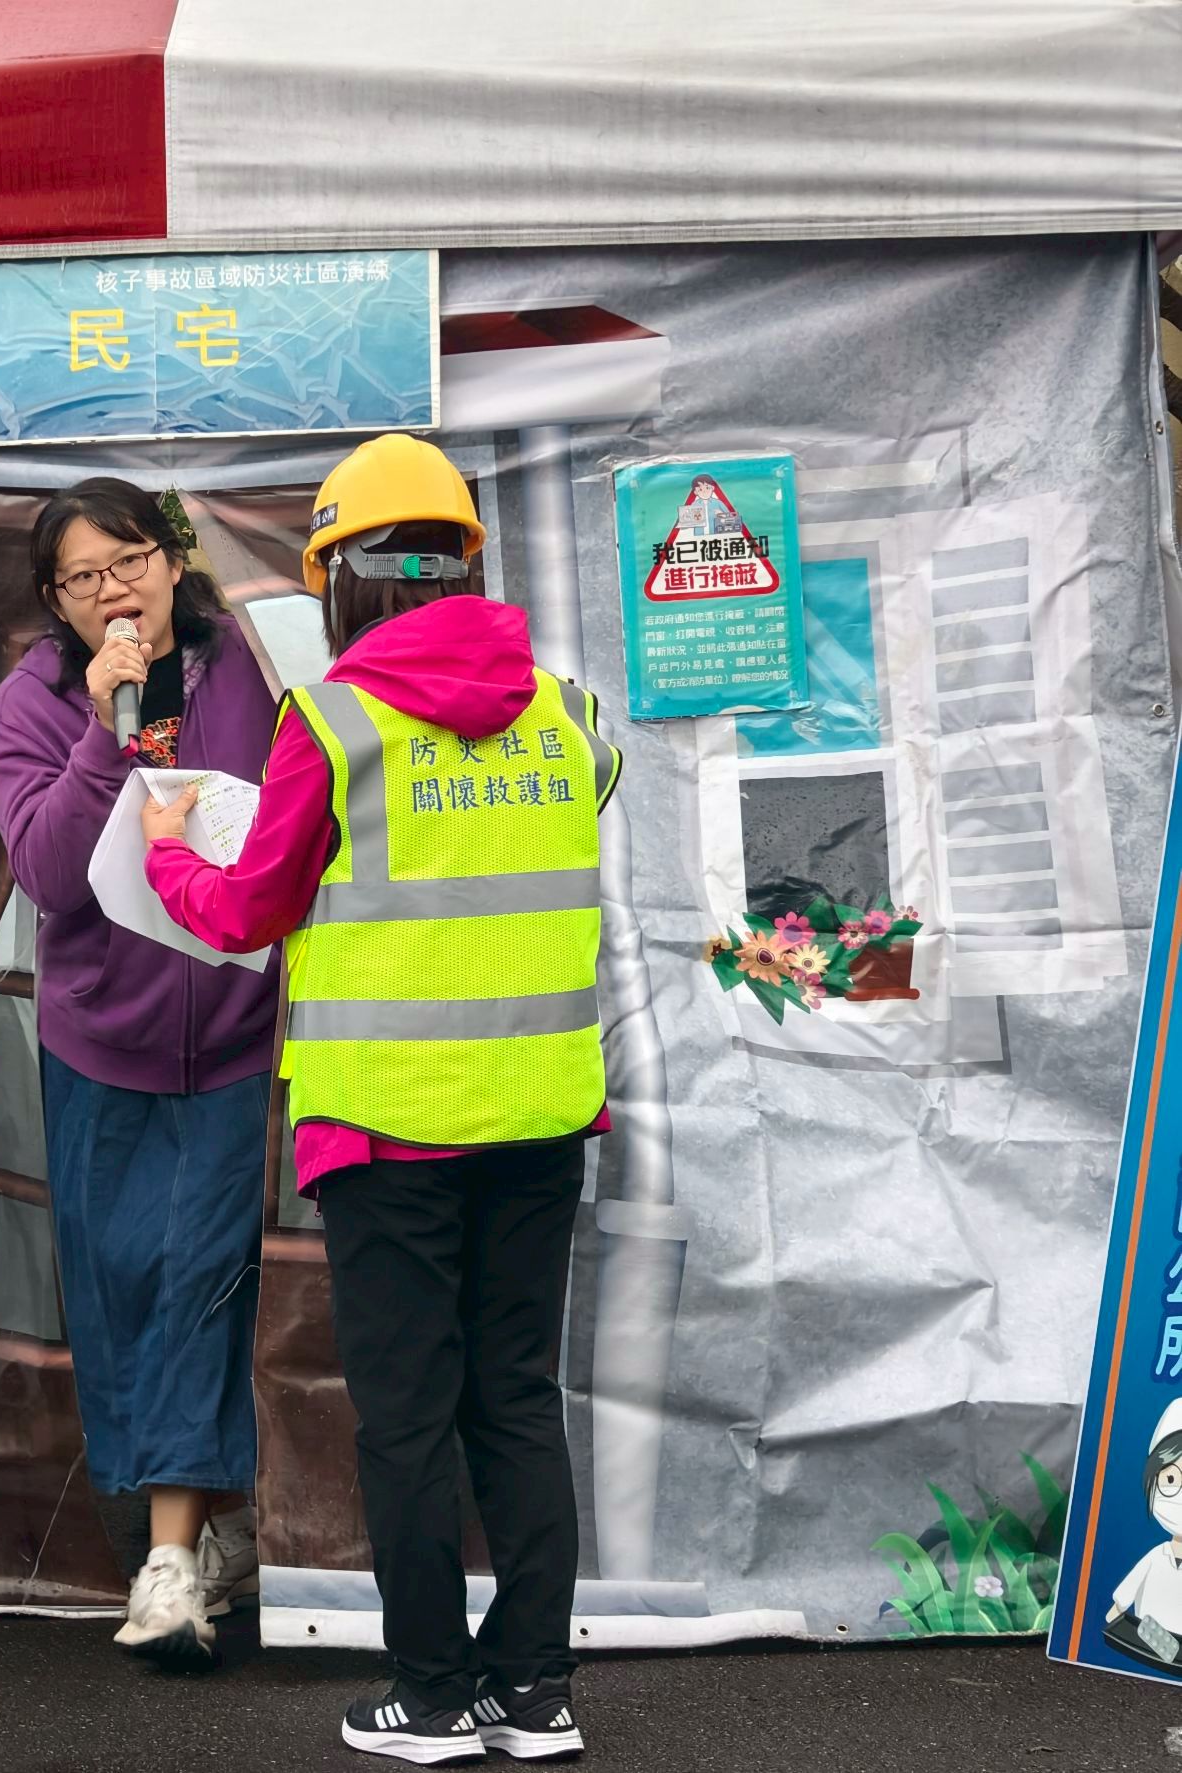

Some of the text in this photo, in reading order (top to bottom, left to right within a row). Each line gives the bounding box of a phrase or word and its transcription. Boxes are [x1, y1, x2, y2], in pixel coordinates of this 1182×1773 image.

[96, 259, 390, 293] 核子事故區域防災社區演練
[69, 304, 239, 372] 民宅
[653, 536, 770, 565] 我已被通知
[664, 563, 759, 591] 進行掩蔽
[412, 770, 575, 814] 關懷救護組
